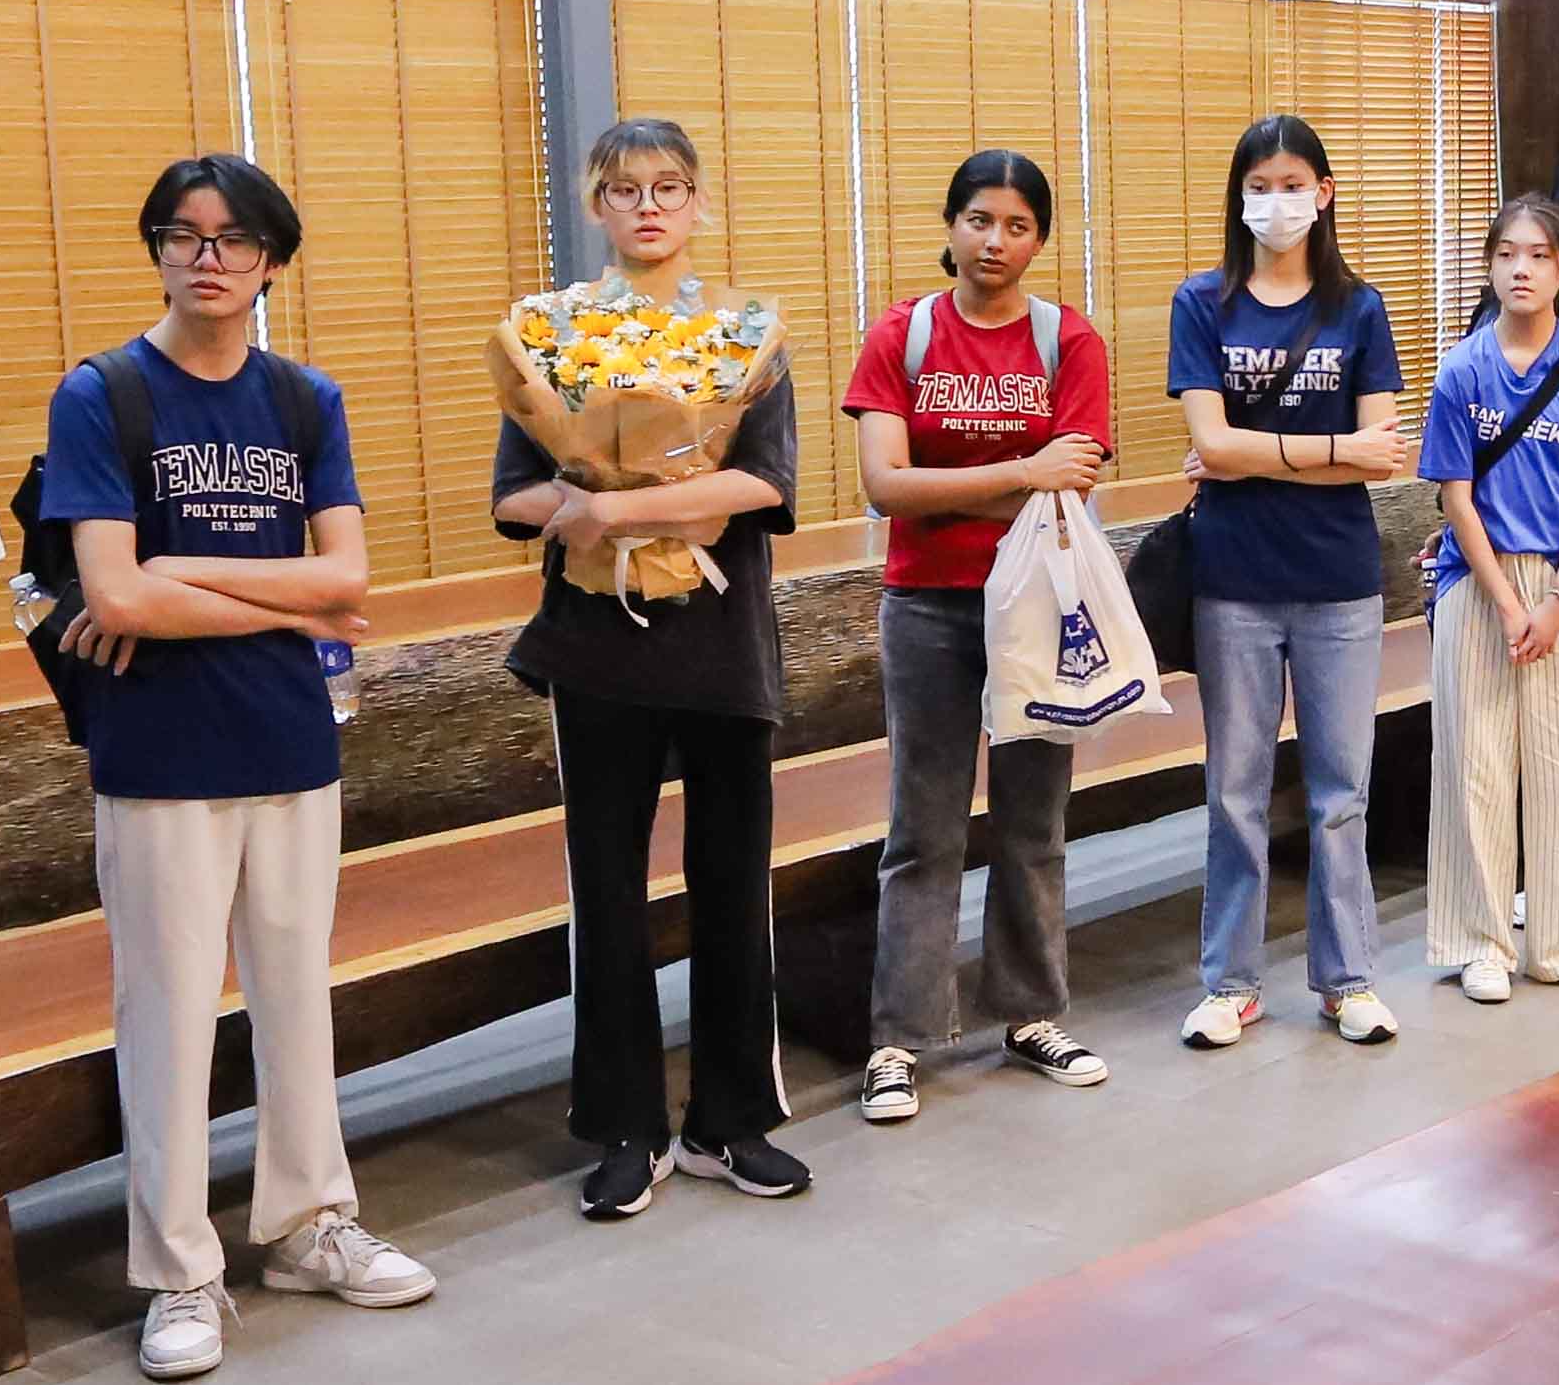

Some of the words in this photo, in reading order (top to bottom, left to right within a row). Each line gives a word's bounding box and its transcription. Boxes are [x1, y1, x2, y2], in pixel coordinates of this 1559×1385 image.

[1221, 346, 1343, 373] EMAEK
[1224, 373, 1341, 391] OLYTHNIC
[1467, 403, 1506, 424] TAM
[941, 417, 1028, 432] POLYTECHNIC
